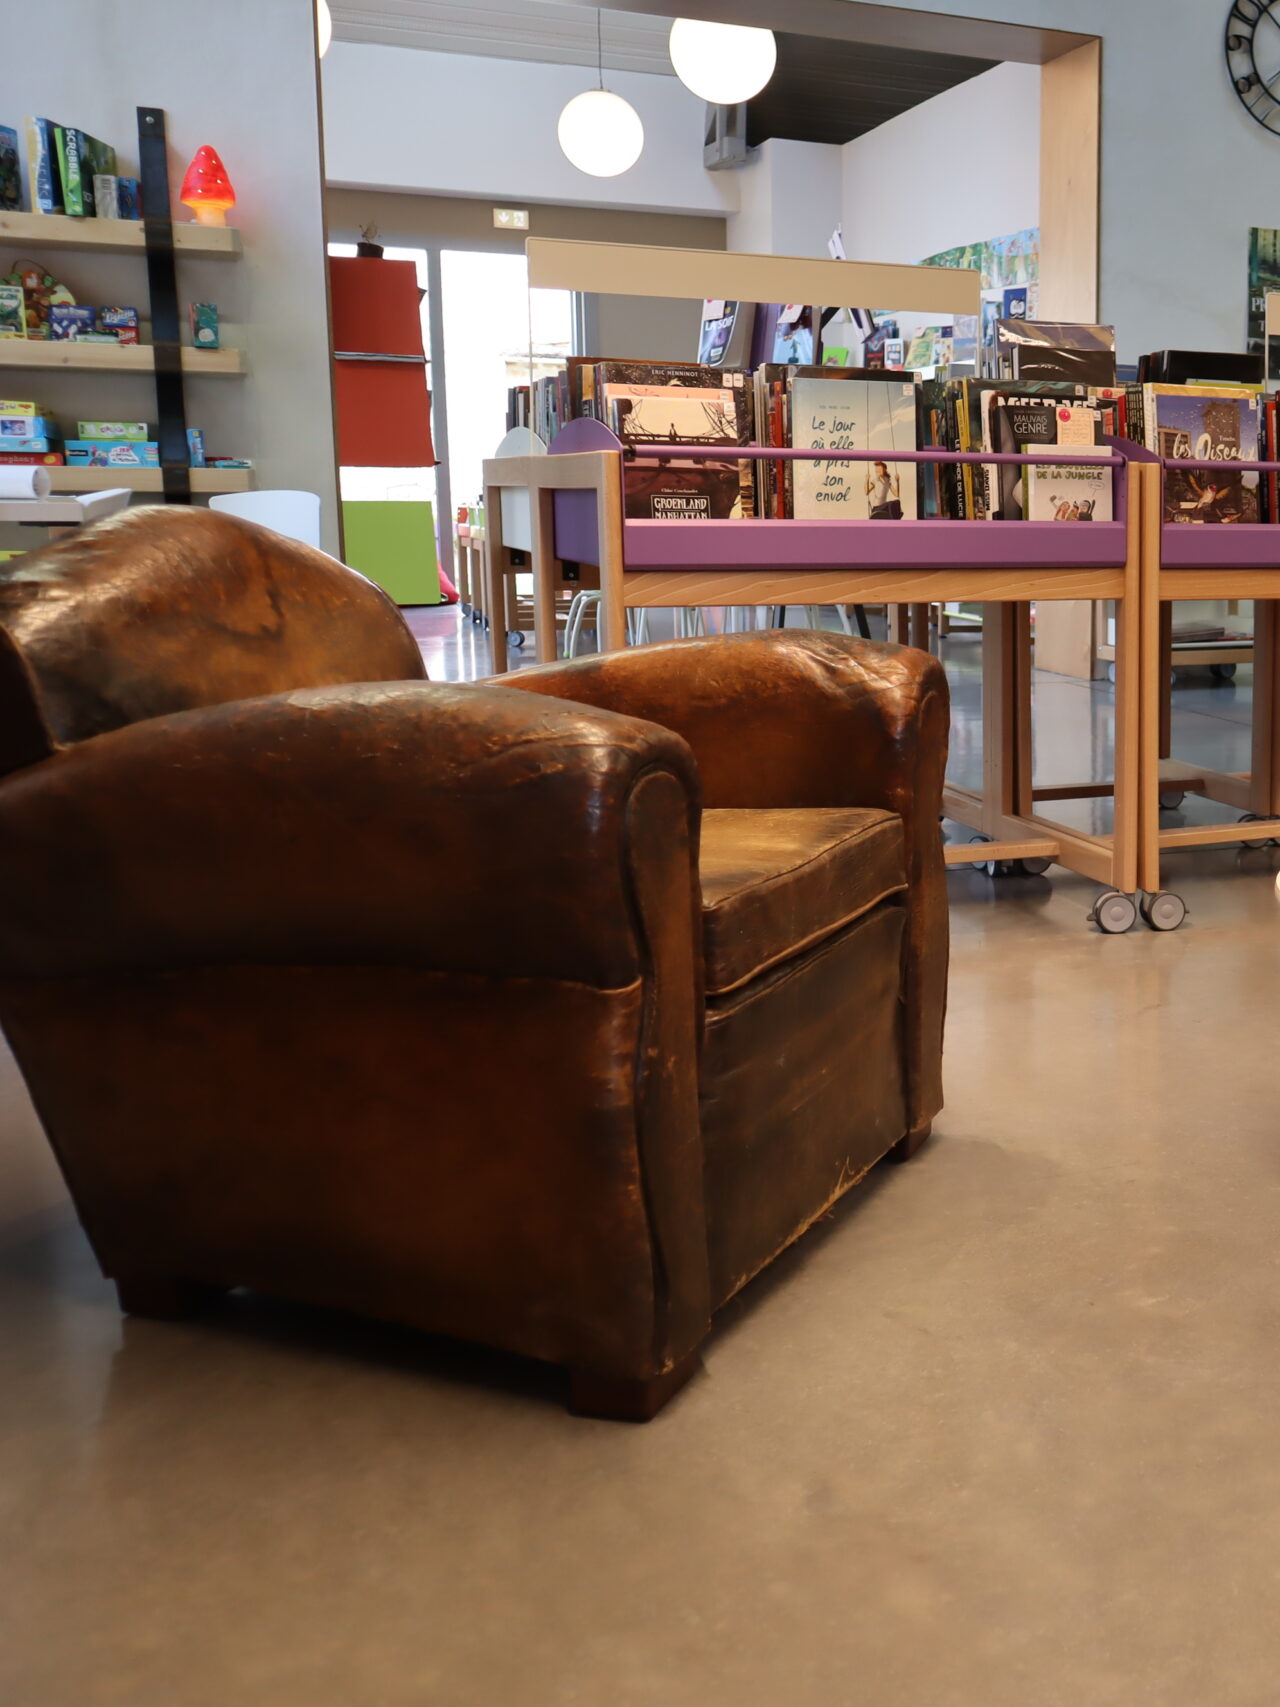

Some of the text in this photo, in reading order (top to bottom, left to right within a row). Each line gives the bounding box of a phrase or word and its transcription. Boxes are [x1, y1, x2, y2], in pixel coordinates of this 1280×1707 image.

[65, 129, 80, 180] SCRABBLE
[811, 415, 856, 433] Le jour
[1013, 415, 1047, 423] MAUVAIS
[1014, 422, 1048, 434] GENRE
[829, 435, 854, 450] elle
[823, 474, 844, 487] son
[1036, 471, 1103, 480] DE LA JUNGLE
[815, 486, 851, 501] envol
[653, 498, 707, 511] GROENLAND
